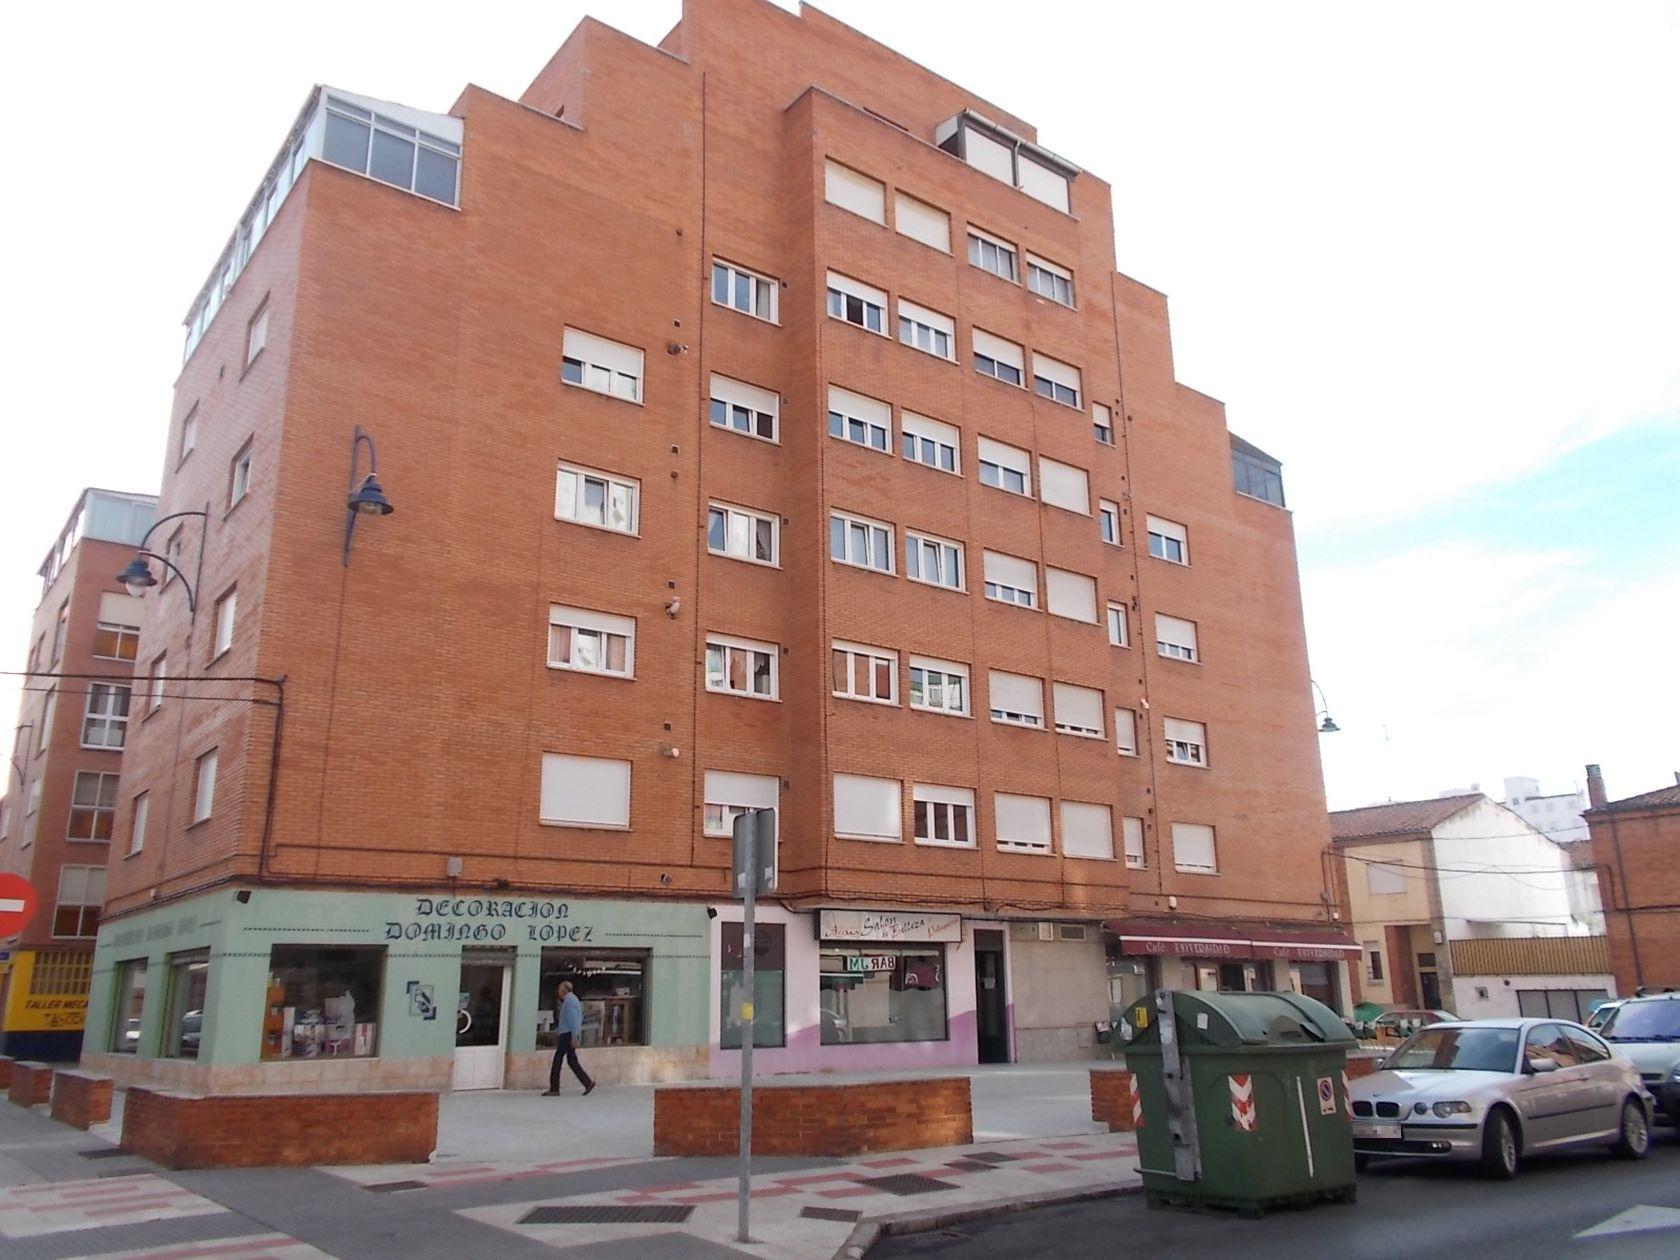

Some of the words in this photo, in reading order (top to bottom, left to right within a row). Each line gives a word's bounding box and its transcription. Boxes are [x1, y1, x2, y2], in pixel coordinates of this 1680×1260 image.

[416, 899, 569, 919] DECORACION
[386, 922, 506, 941] DOMINGO
[25, 1000, 63, 1009] TALLER
